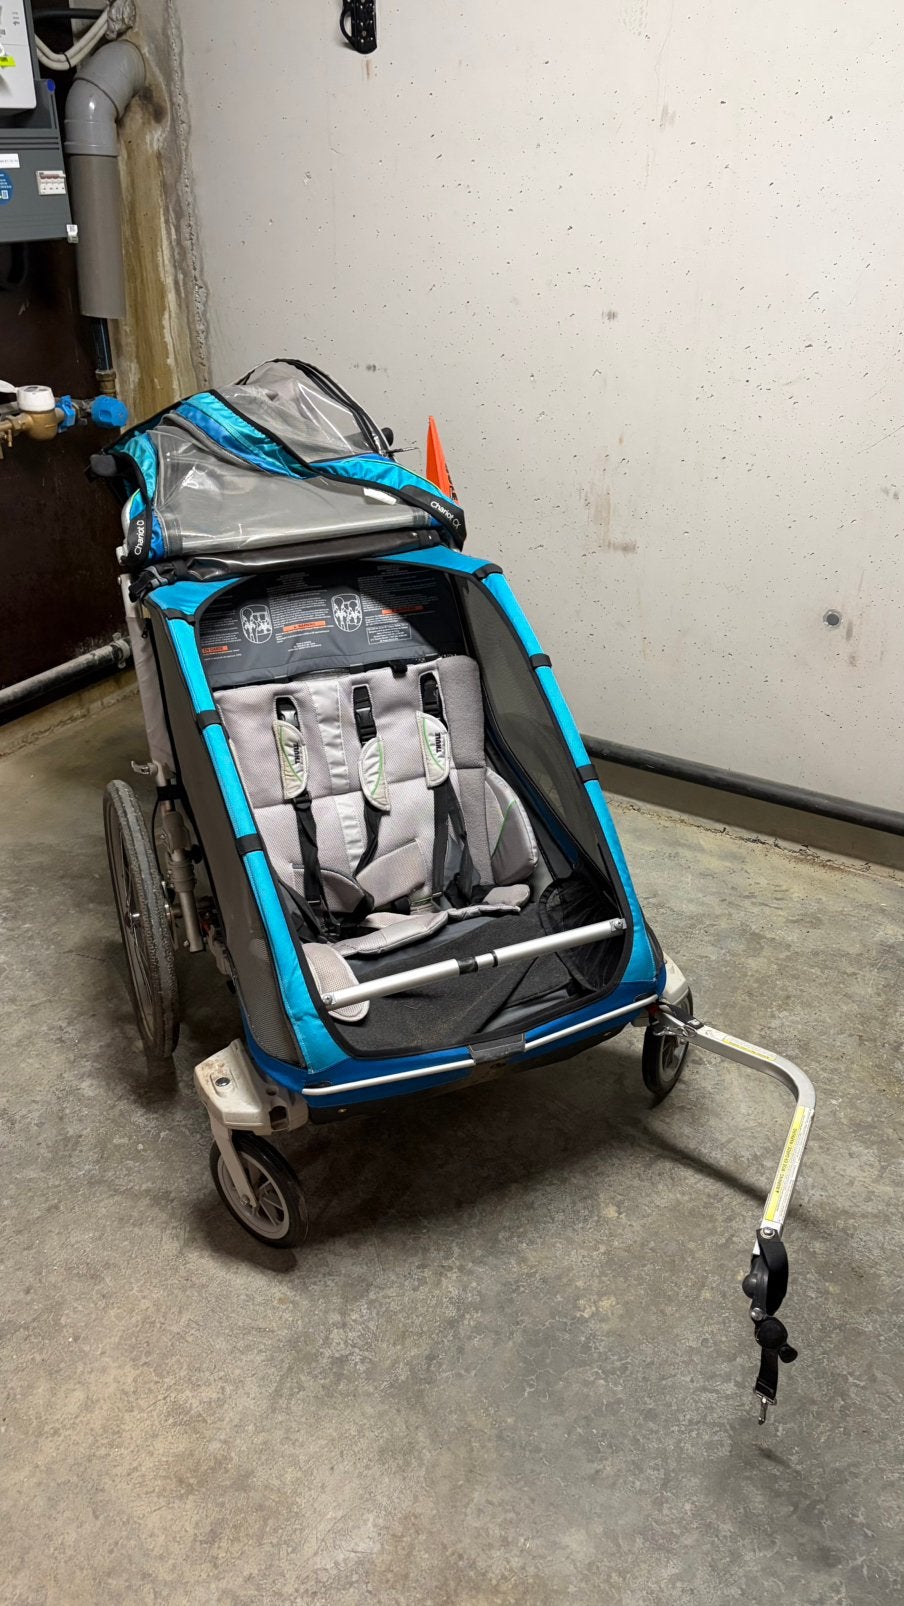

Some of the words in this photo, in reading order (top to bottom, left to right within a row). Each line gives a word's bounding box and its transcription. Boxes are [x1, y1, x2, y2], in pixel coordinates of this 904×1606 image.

[430, 501, 454, 520] Chariot
[134, 526, 145, 555] Chariot
[293, 742, 301, 764] THULE
[434, 732, 442, 753] THULE
